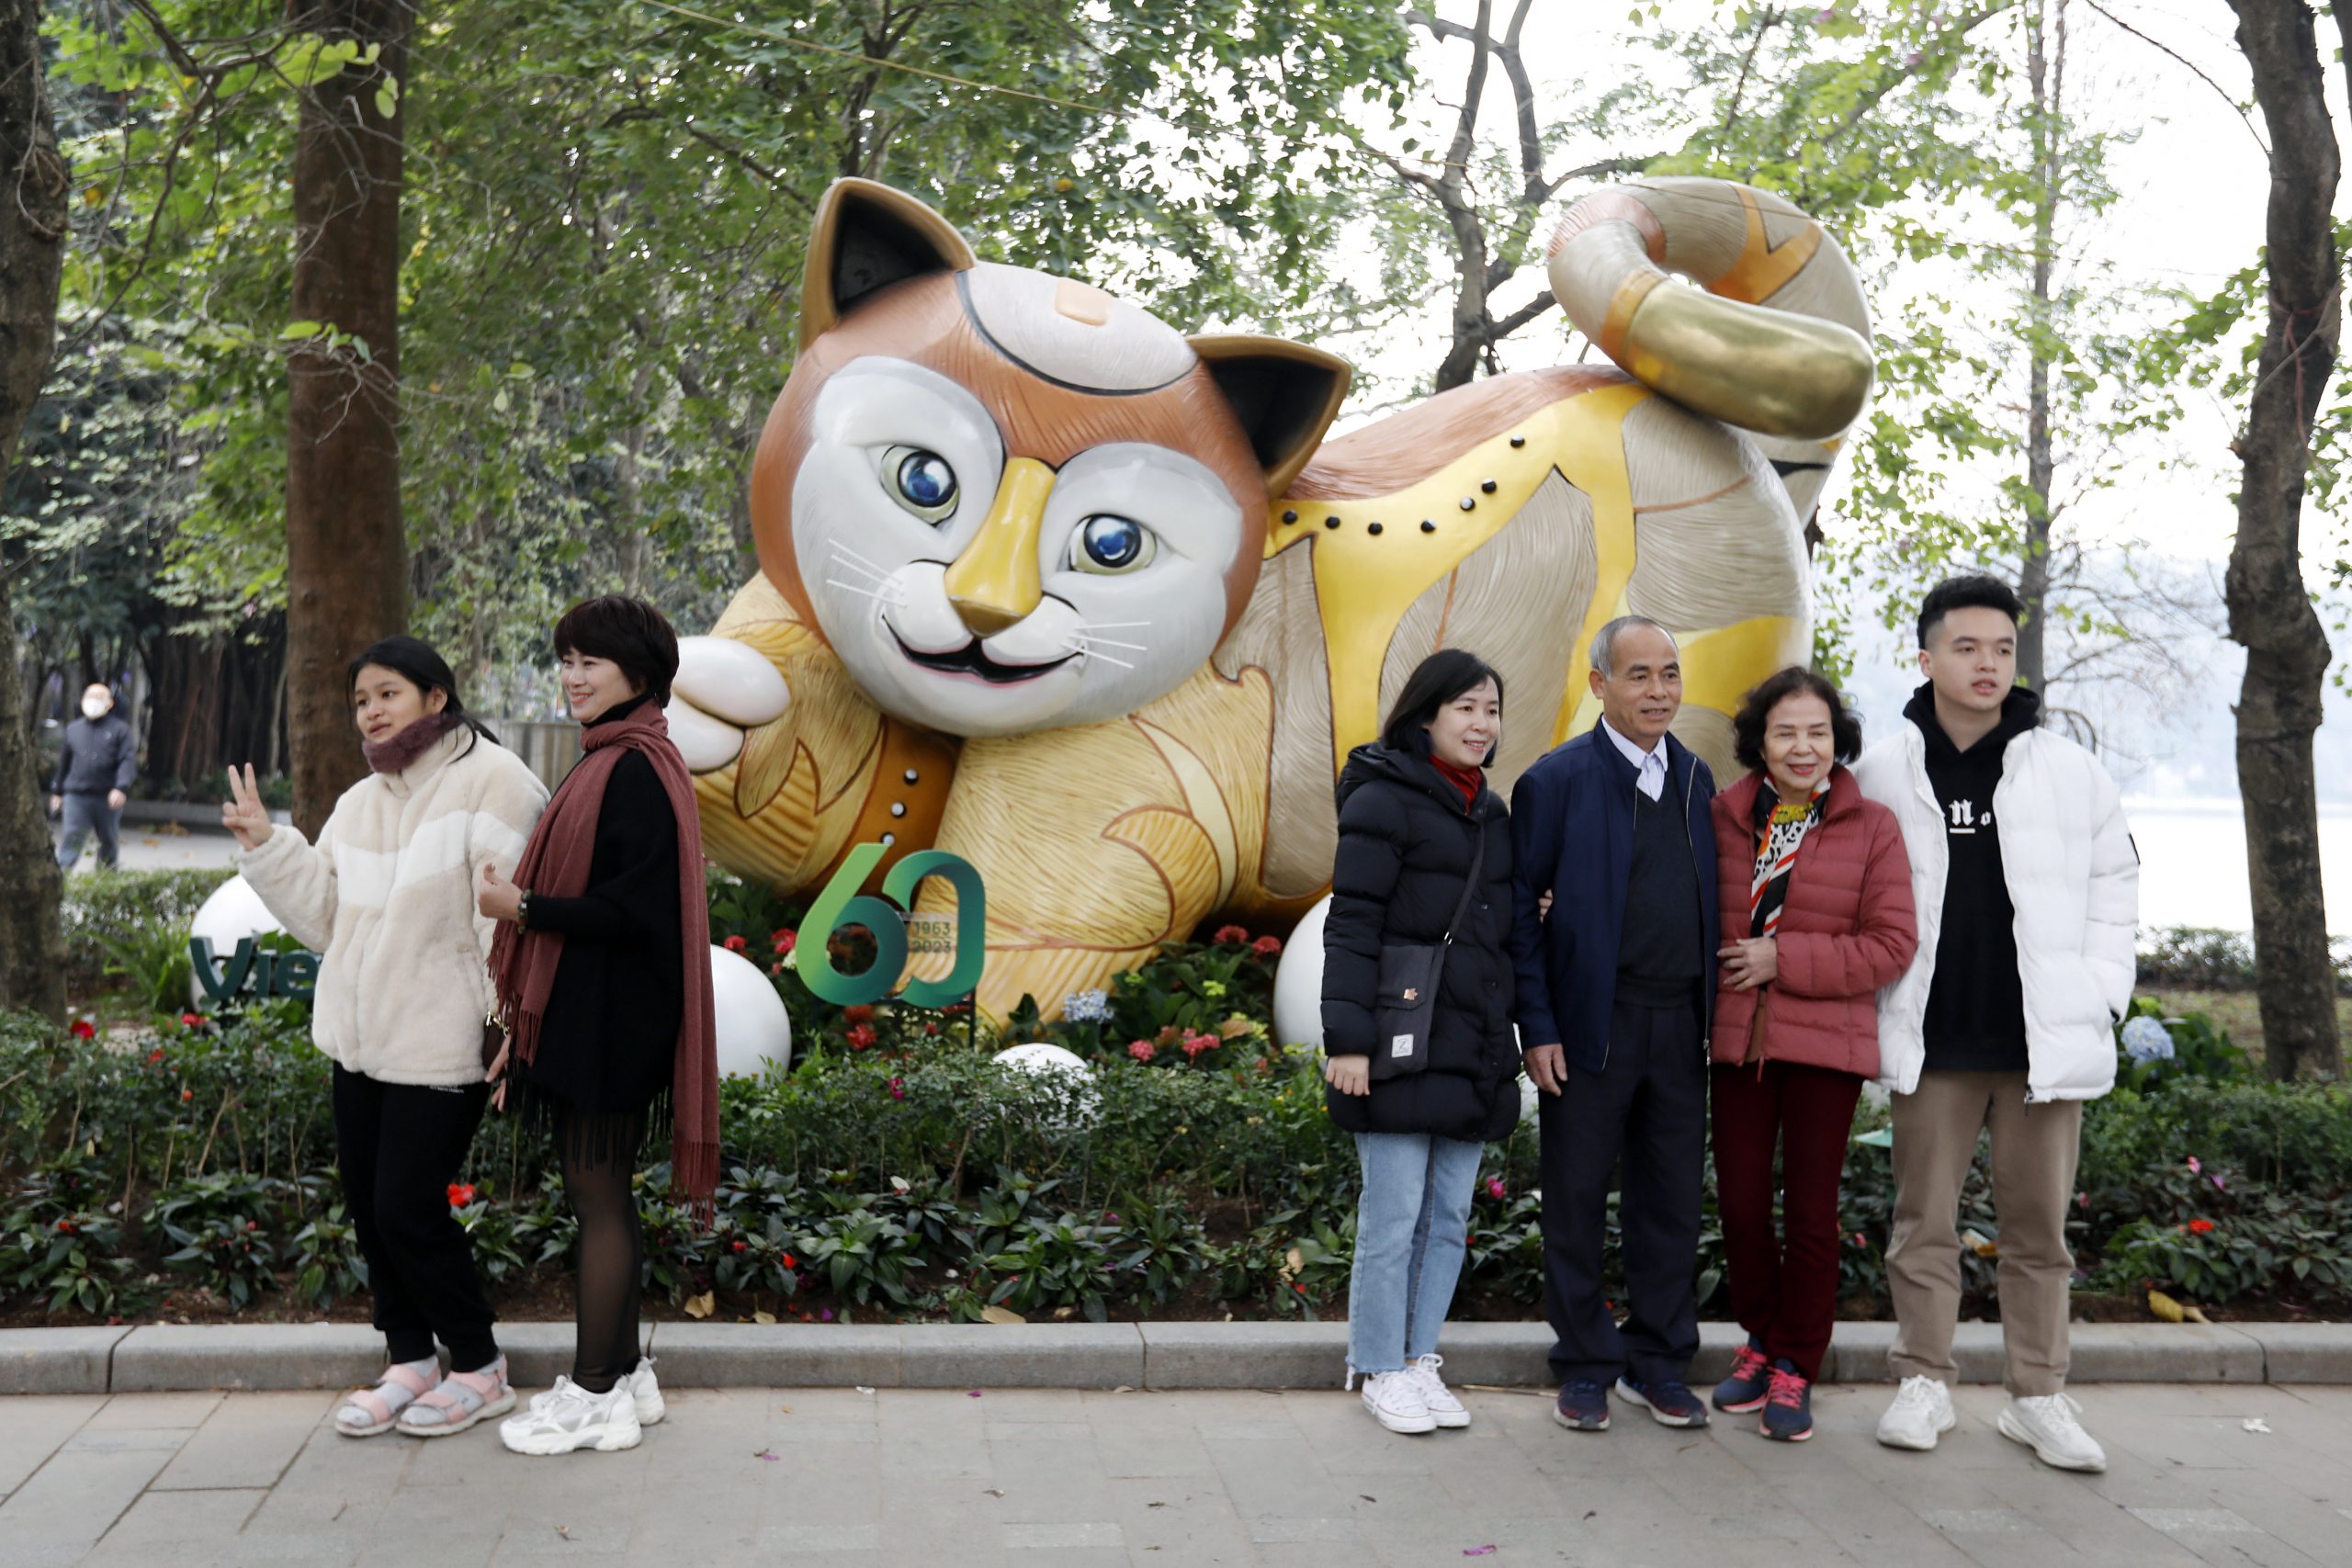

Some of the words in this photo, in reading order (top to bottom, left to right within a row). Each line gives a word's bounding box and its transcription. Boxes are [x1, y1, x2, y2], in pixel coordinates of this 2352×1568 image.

[795, 841, 986, 1008] 60
[913, 921, 951, 935] 1963
[910, 940, 952, 953] 2023
